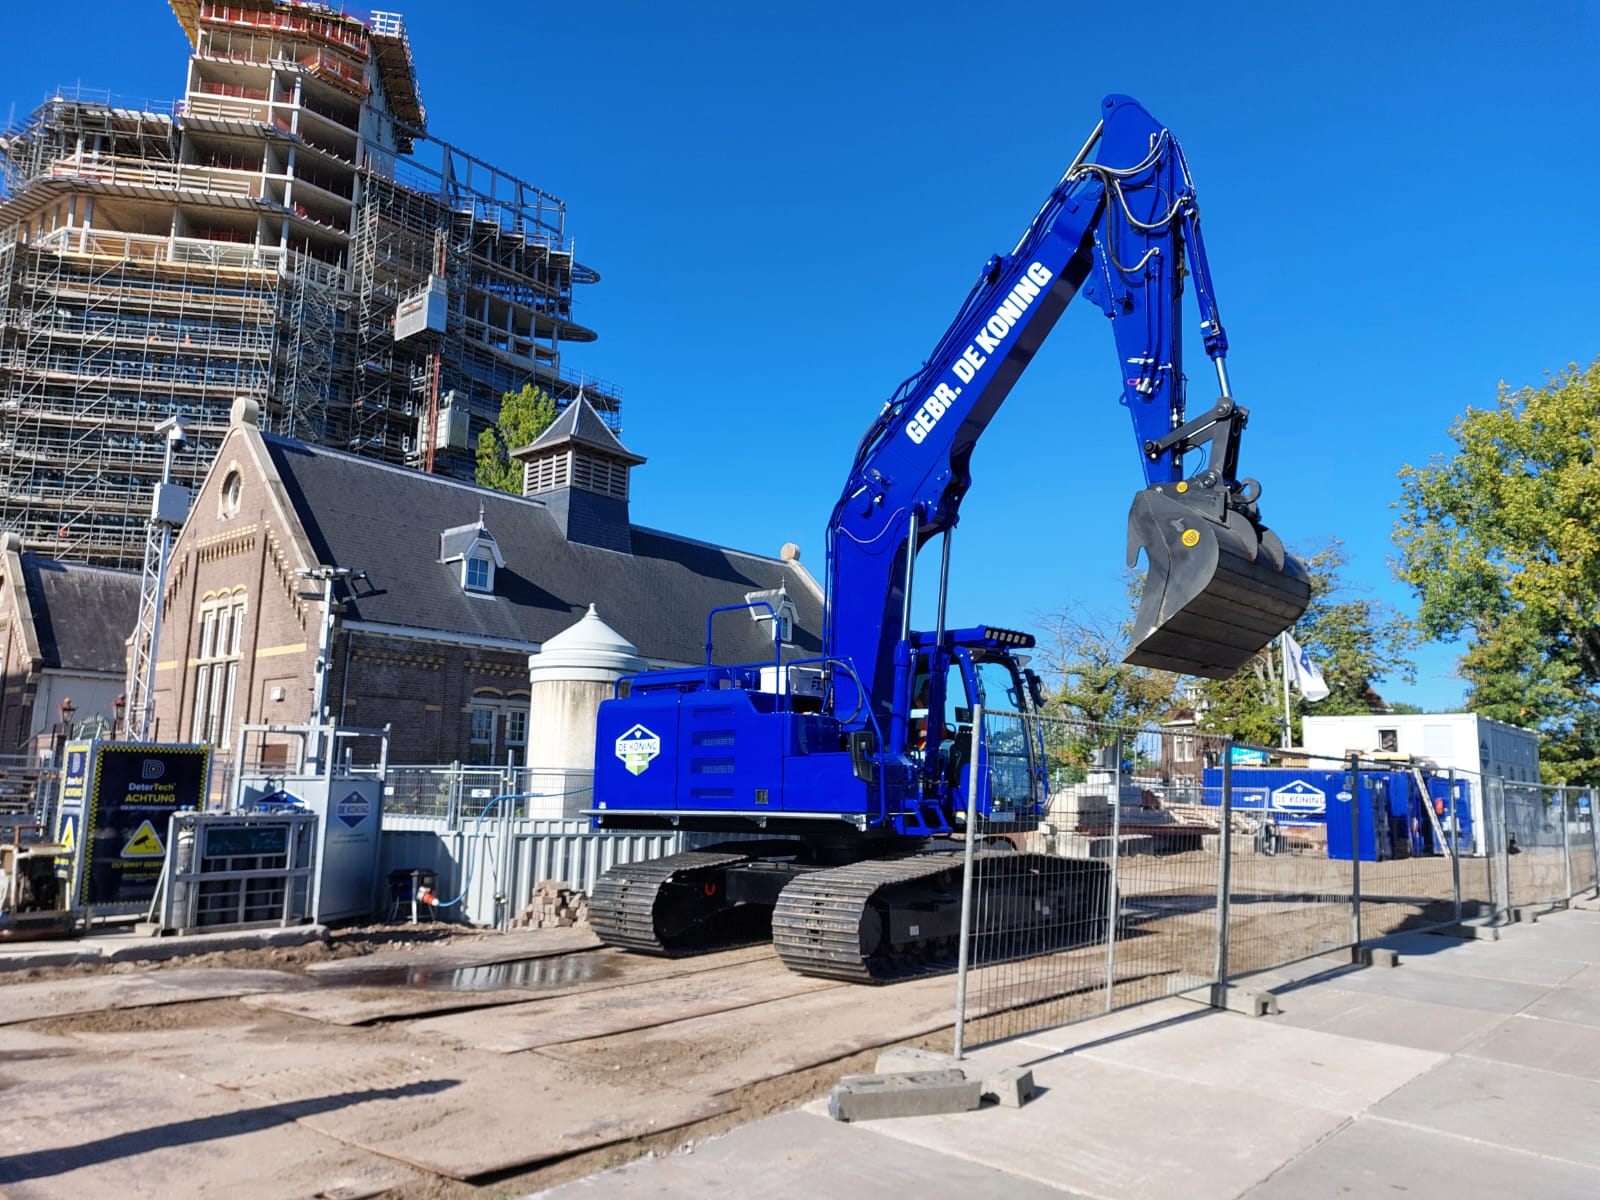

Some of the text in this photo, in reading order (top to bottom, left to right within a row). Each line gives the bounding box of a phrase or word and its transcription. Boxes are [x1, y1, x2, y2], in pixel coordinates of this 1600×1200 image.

[905, 261, 1053, 445] GEBR. DE KONING
[618, 741, 658, 752] DE KONING
[128, 782, 174, 792] DeterTech
[125, 794, 176, 803] ACHTUNG
